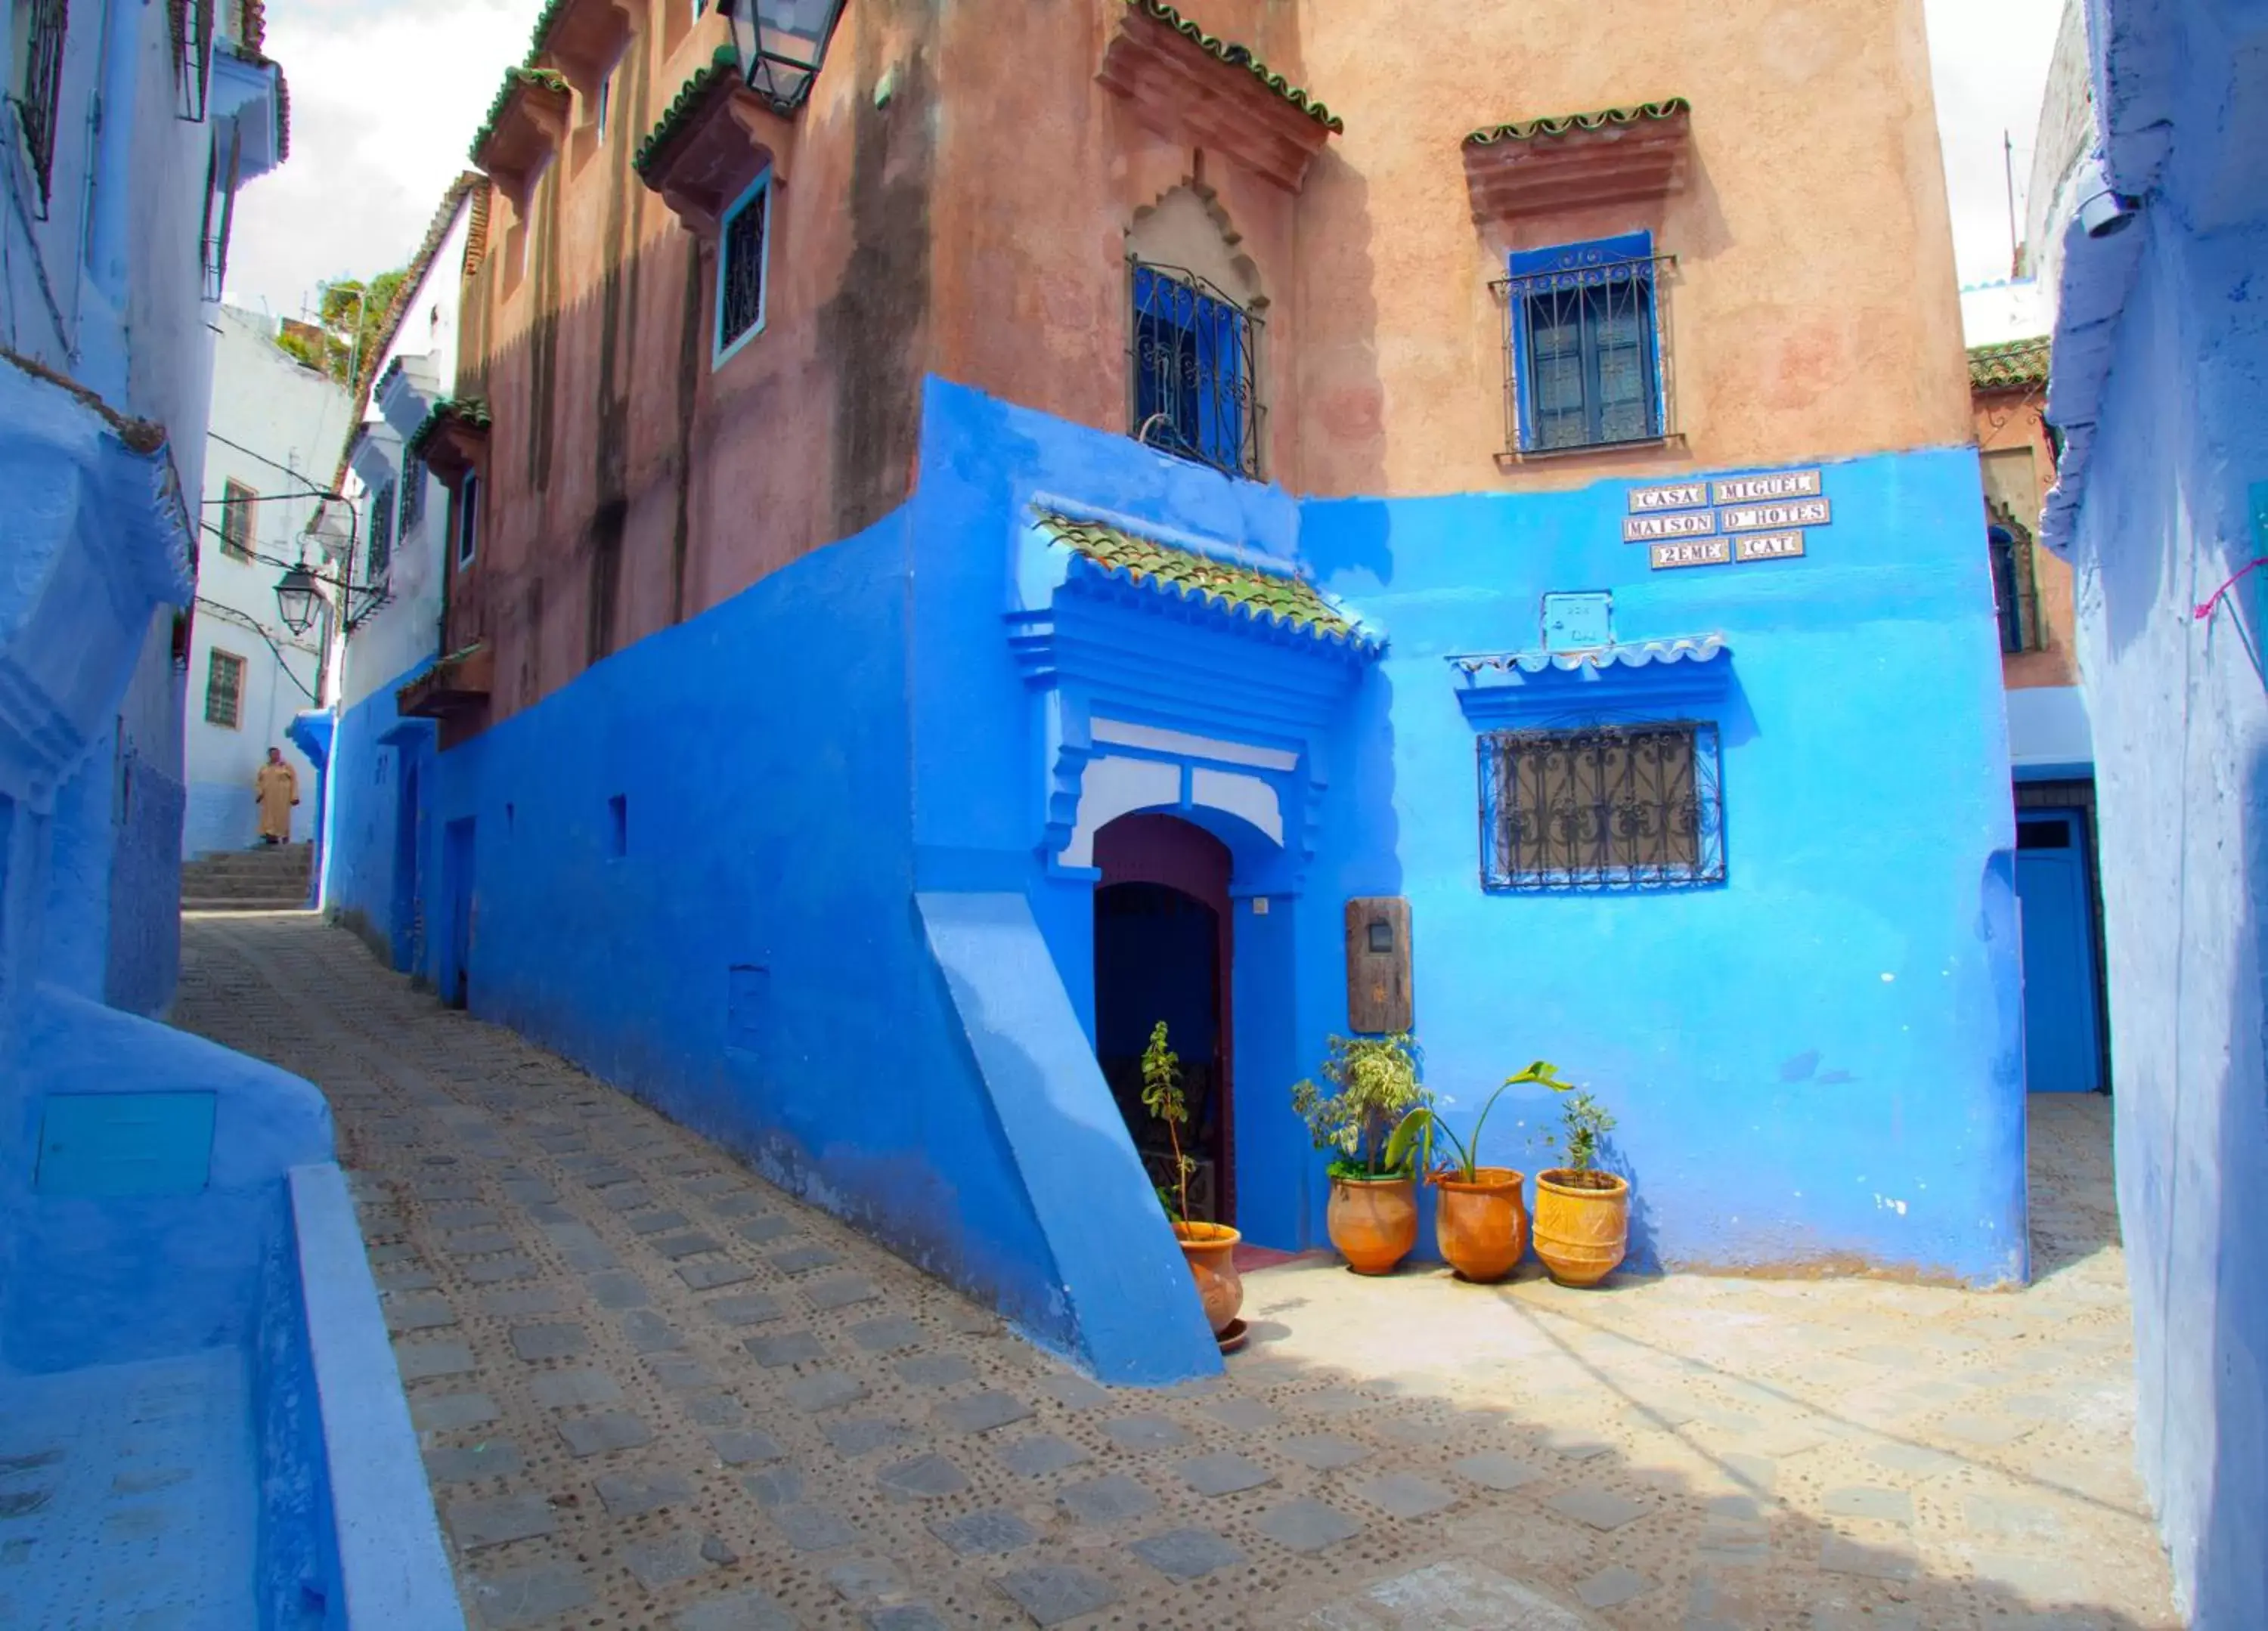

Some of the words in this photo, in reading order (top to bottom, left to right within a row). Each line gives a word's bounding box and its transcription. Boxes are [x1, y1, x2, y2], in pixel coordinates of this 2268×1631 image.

[1642, 490, 1694, 506] CASA
[1727, 478, 1807, 498] MIGUEL
[1631, 515, 1709, 534] MAISON
[1728, 505, 1822, 527] D'HOTES
[1665, 543, 1718, 561] 2EME
[1750, 537, 1790, 554] CAT
